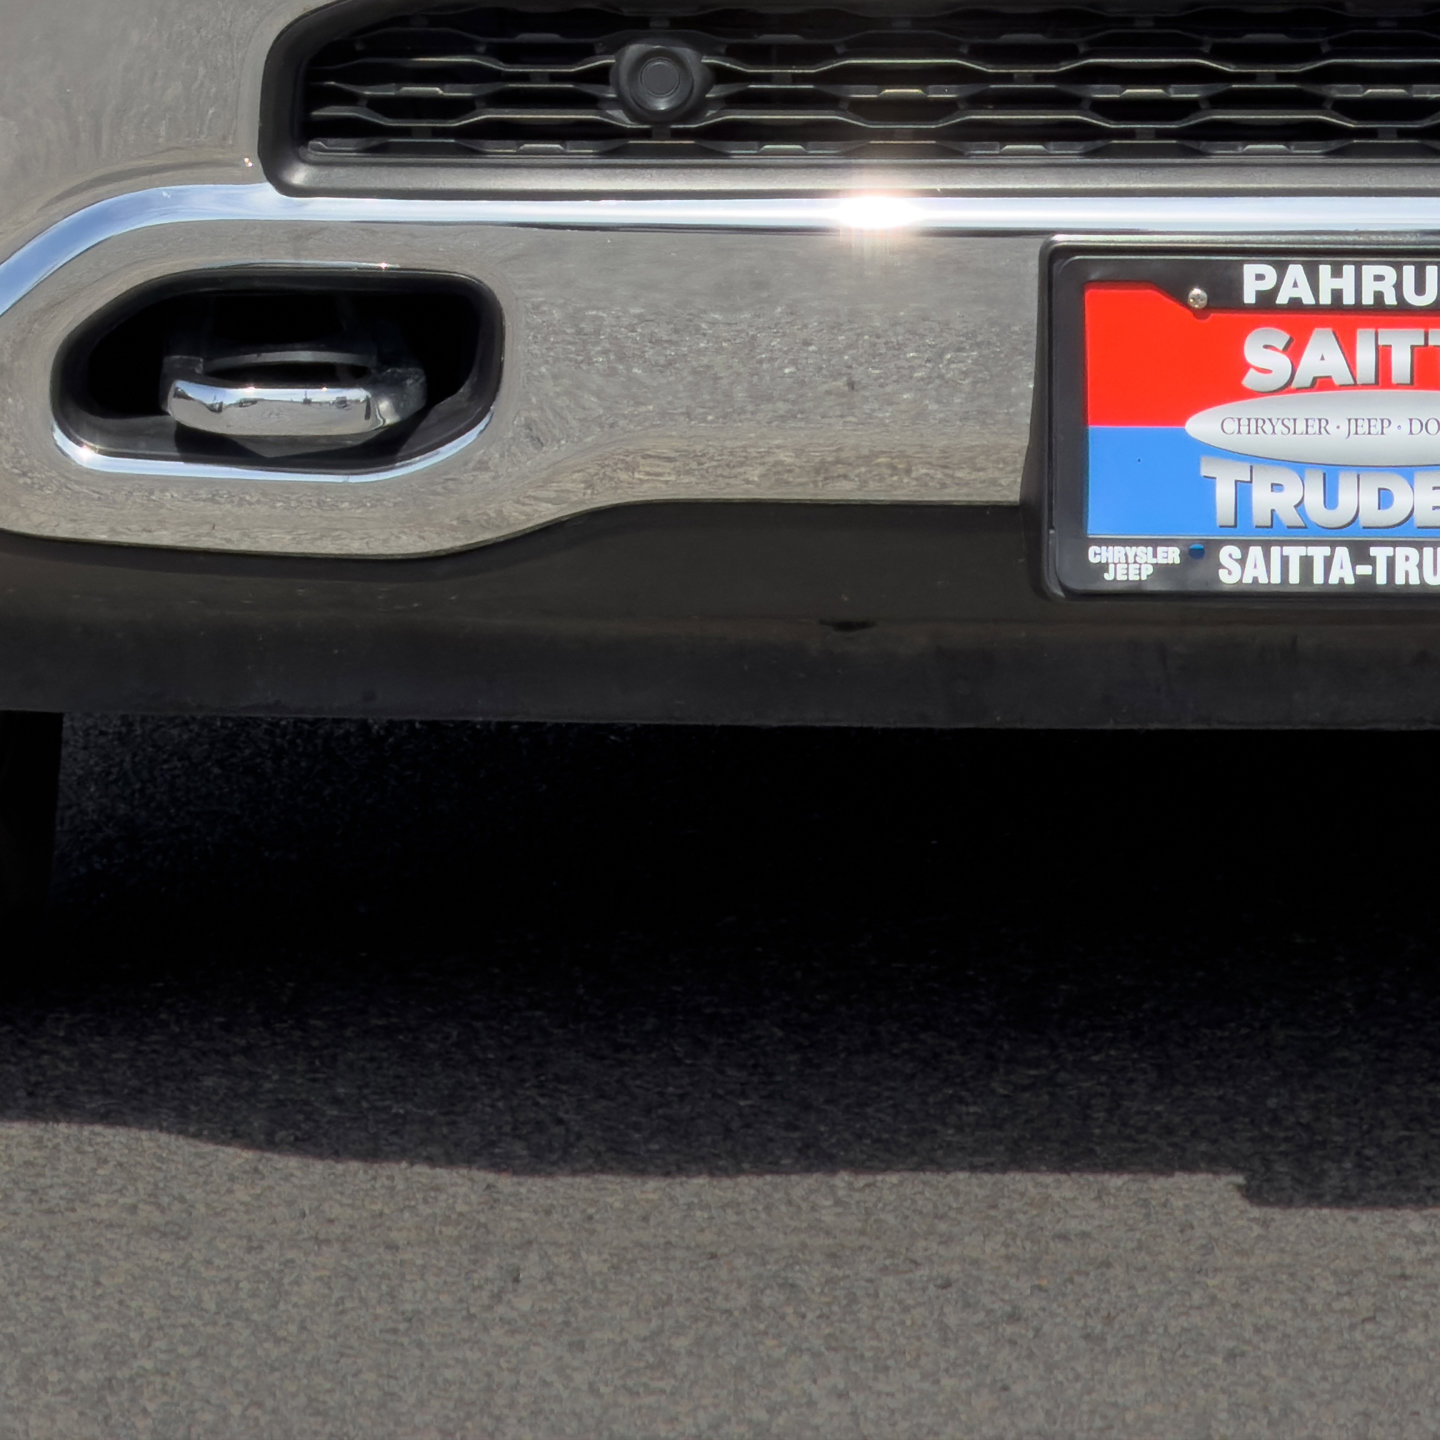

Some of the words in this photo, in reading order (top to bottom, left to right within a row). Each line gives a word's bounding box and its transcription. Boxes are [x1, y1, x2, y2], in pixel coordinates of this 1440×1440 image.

[1220, 416, 1331, 436] CHRYSLER
[1345, 416, 1393, 440] JEEP
[1088, 545, 1181, 565] CHRYSLER
[1103, 563, 1154, 581] JEEP
